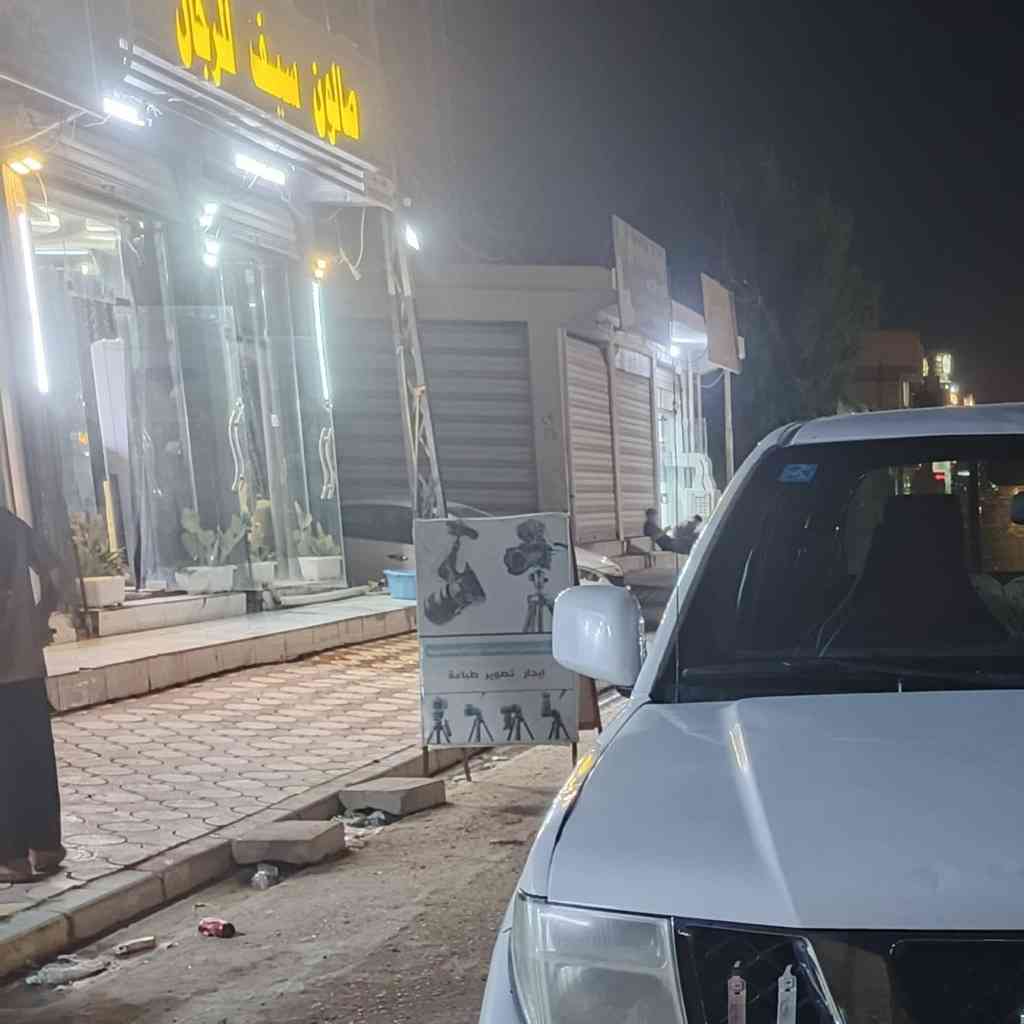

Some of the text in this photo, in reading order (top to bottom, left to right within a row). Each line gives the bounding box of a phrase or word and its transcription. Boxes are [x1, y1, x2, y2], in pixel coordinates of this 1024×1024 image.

[249, 12, 301, 120] سيف
[312, 61, 360, 145] صالون
[485, 669, 515, 681] تصوير
